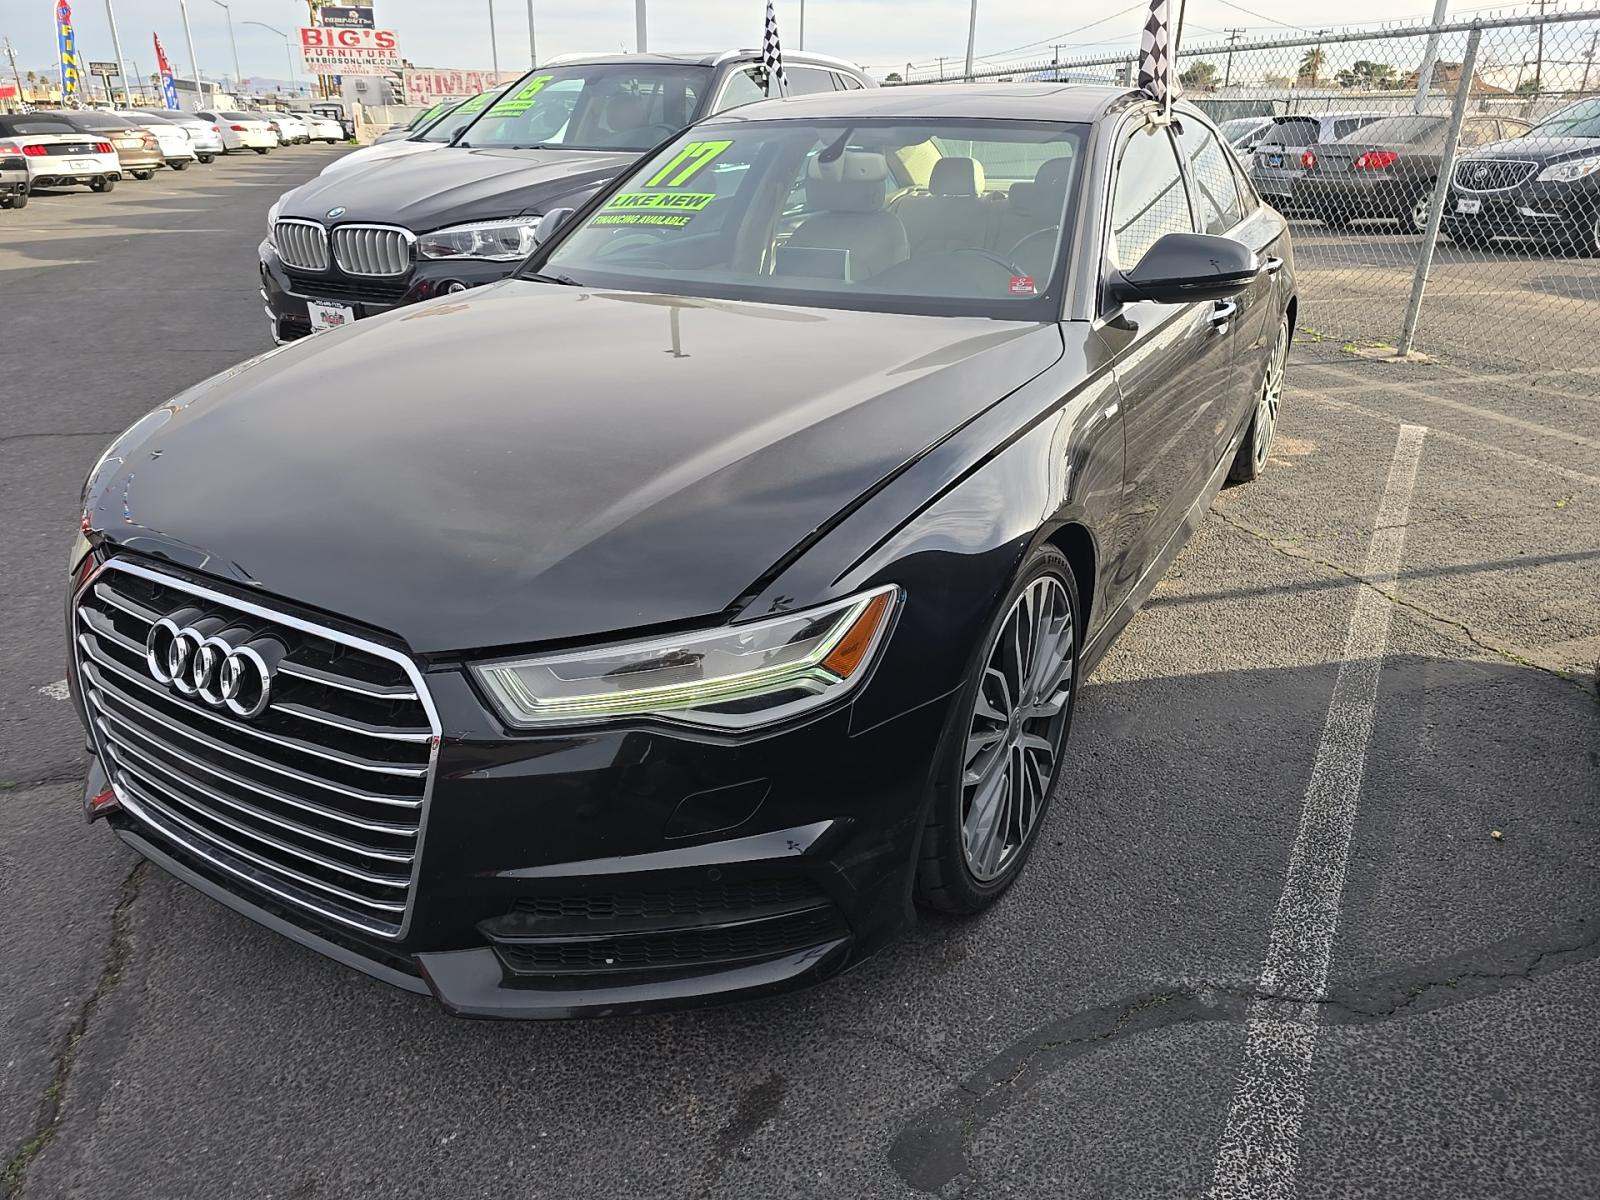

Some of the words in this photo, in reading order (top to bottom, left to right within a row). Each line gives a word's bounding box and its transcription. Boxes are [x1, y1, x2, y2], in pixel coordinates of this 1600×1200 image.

[301, 28, 395, 48] BIG'S
[304, 48, 397, 58] FURNITURE
[643, 140, 734, 187] 17
[608, 194, 658, 207] LIKE
[656, 194, 710, 207] NEW
[591, 214, 641, 225] FINANCING
[637, 215, 692, 226] AVAILABLE
